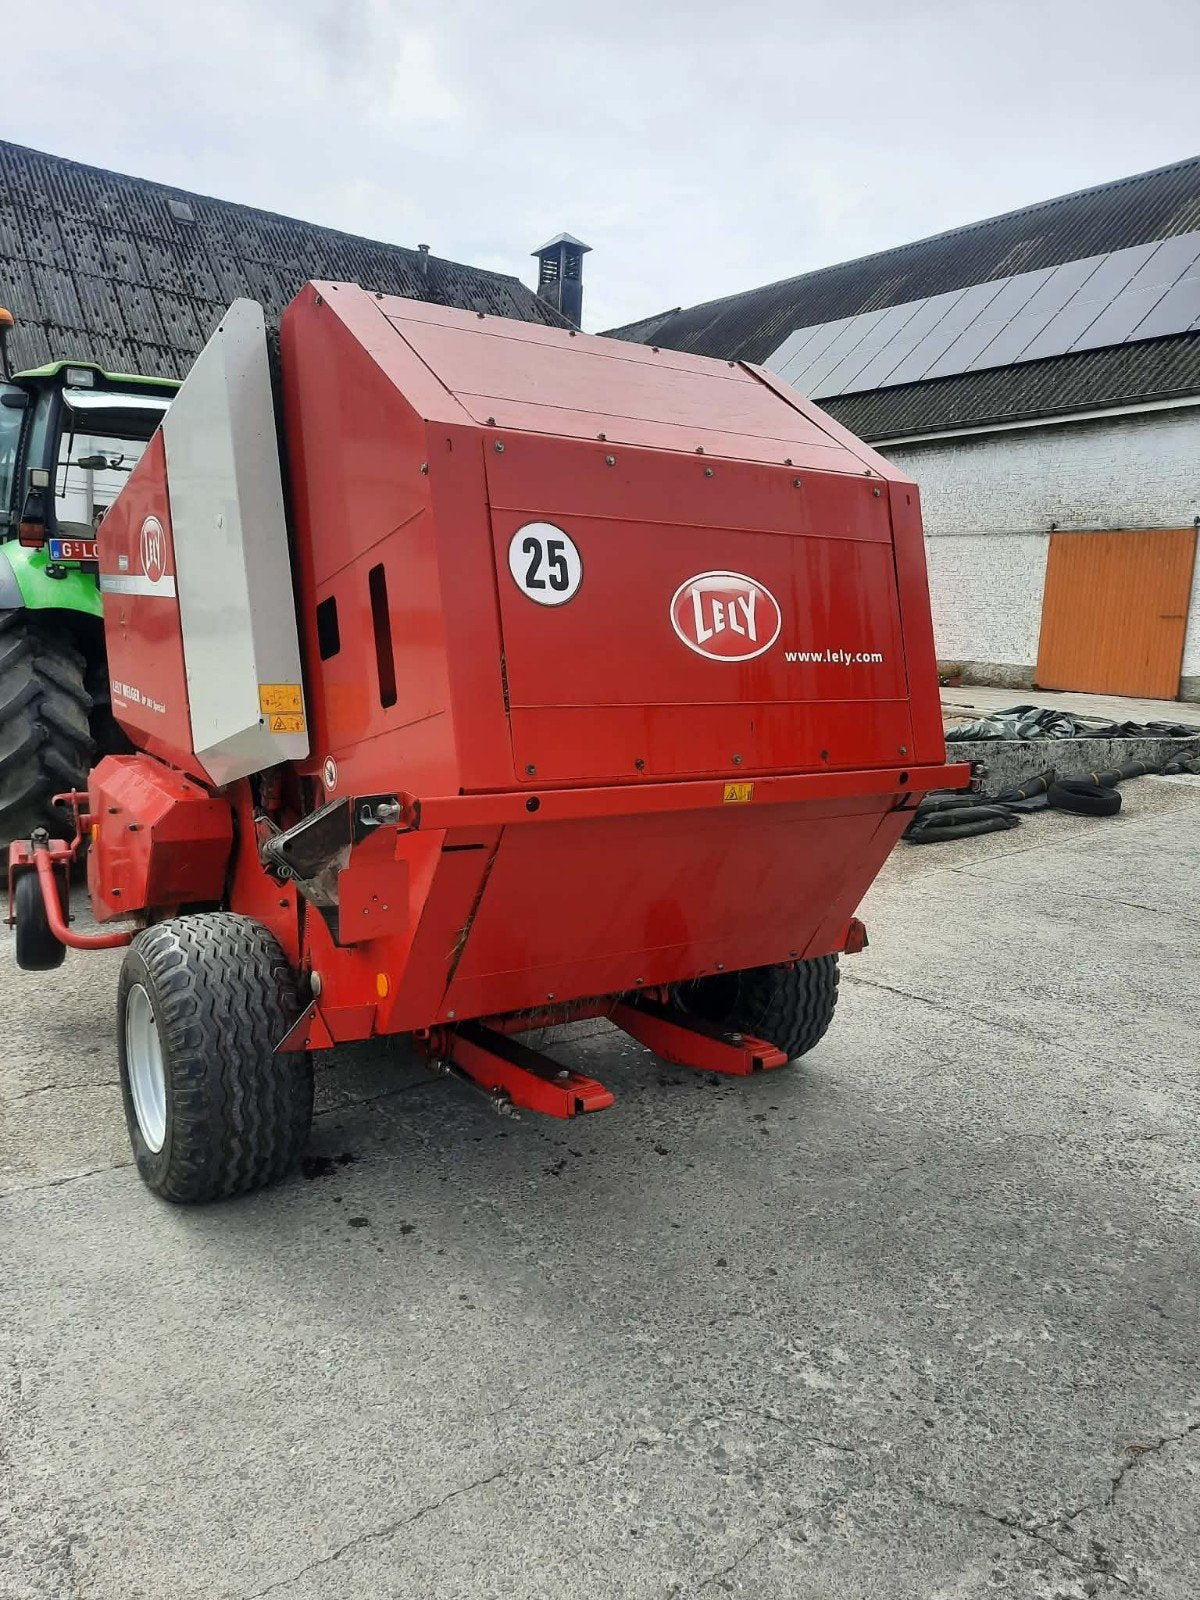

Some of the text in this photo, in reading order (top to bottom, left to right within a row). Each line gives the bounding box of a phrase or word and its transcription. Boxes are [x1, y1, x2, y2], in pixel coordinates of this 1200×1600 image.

[521, 537, 569, 591] 25
[691, 588, 757, 644] LELY
[785, 649, 883, 666] www.lely.com
